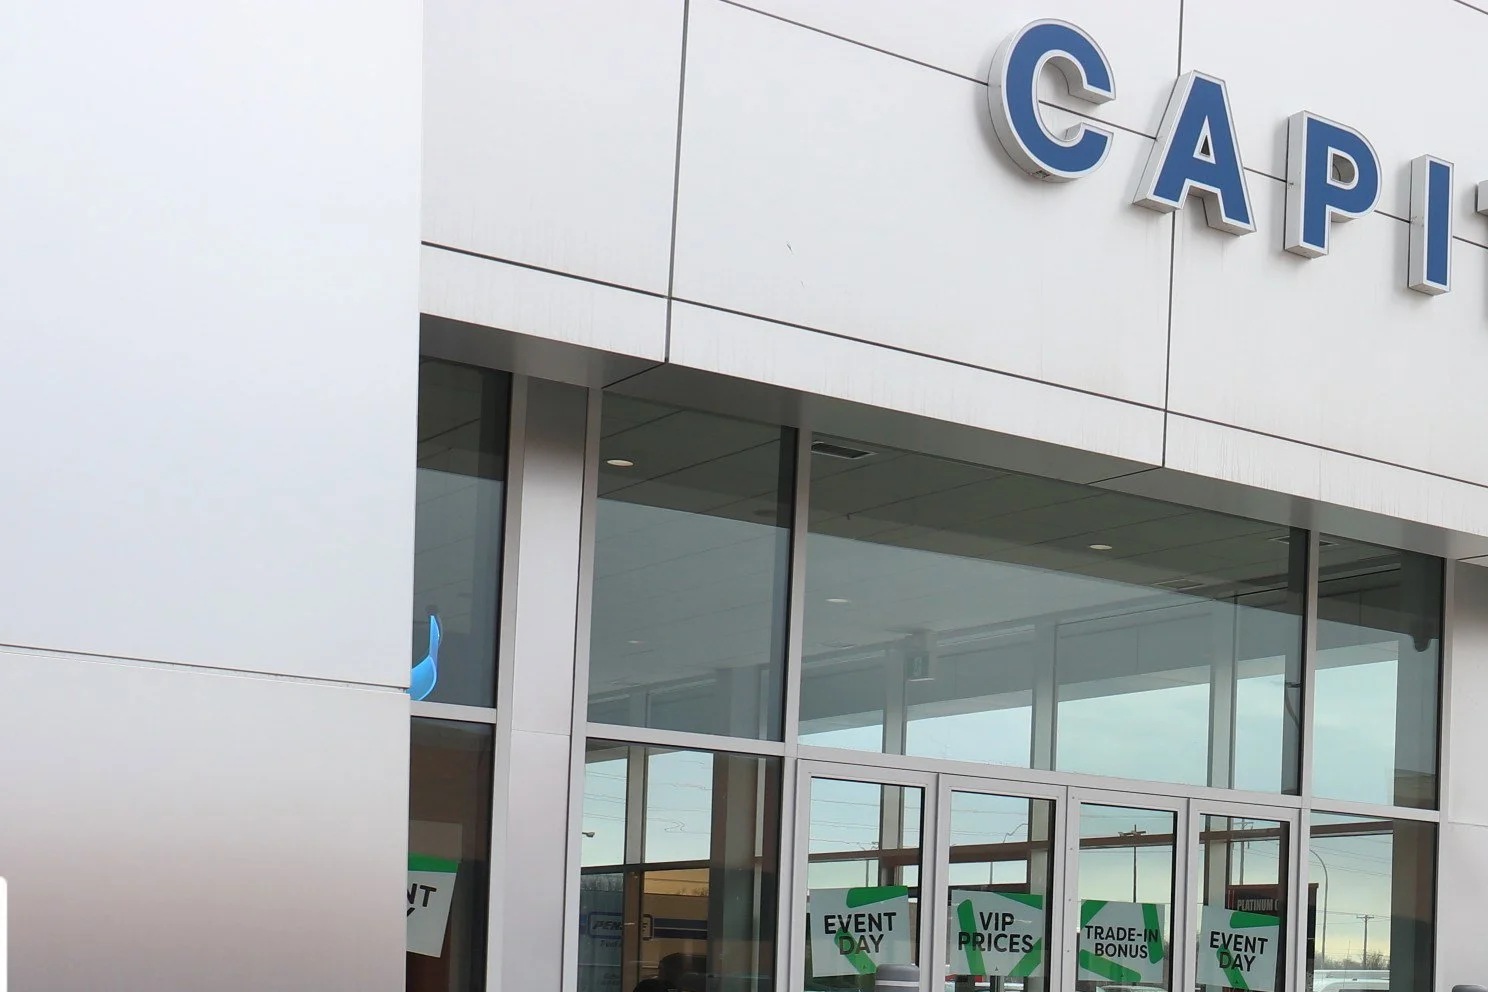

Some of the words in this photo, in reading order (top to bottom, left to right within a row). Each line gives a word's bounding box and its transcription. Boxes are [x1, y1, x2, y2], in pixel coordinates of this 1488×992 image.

[1236, 898, 1274, 912] PLATINUM
[823, 911, 898, 935] EVENT
[978, 911, 1015, 932] VIP
[838, 932, 885, 956] DAY
[957, 932, 1034, 953] PRICES
[1085, 924, 1159, 944] TRADE-IN
[1209, 930, 1269, 956] EVENT
[1094, 942, 1148, 960] BONUS
[1218, 950, 1257, 973] DAY
